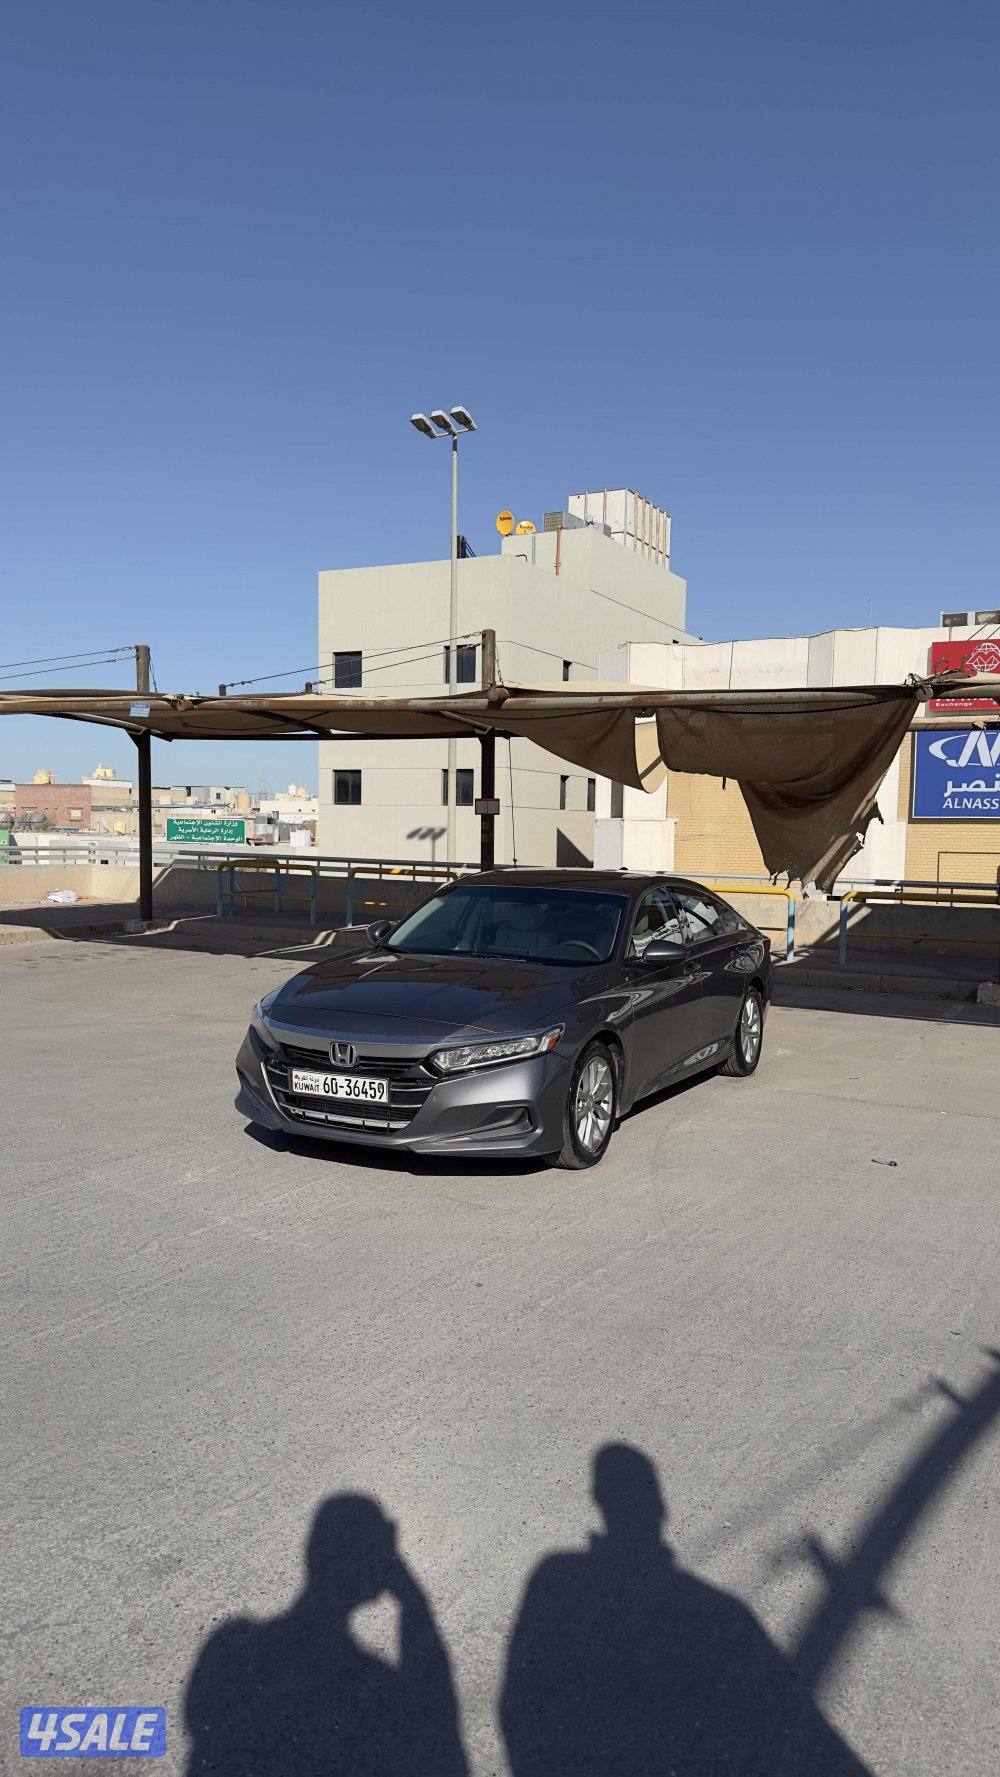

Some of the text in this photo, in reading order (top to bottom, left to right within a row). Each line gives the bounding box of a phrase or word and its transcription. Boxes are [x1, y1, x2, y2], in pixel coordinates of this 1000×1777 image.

[942, 798, 1000, 810] ALNASS
[294, 1082, 320, 1093] KUWAIT
[323, 1077, 385, 1100] 60-36459
